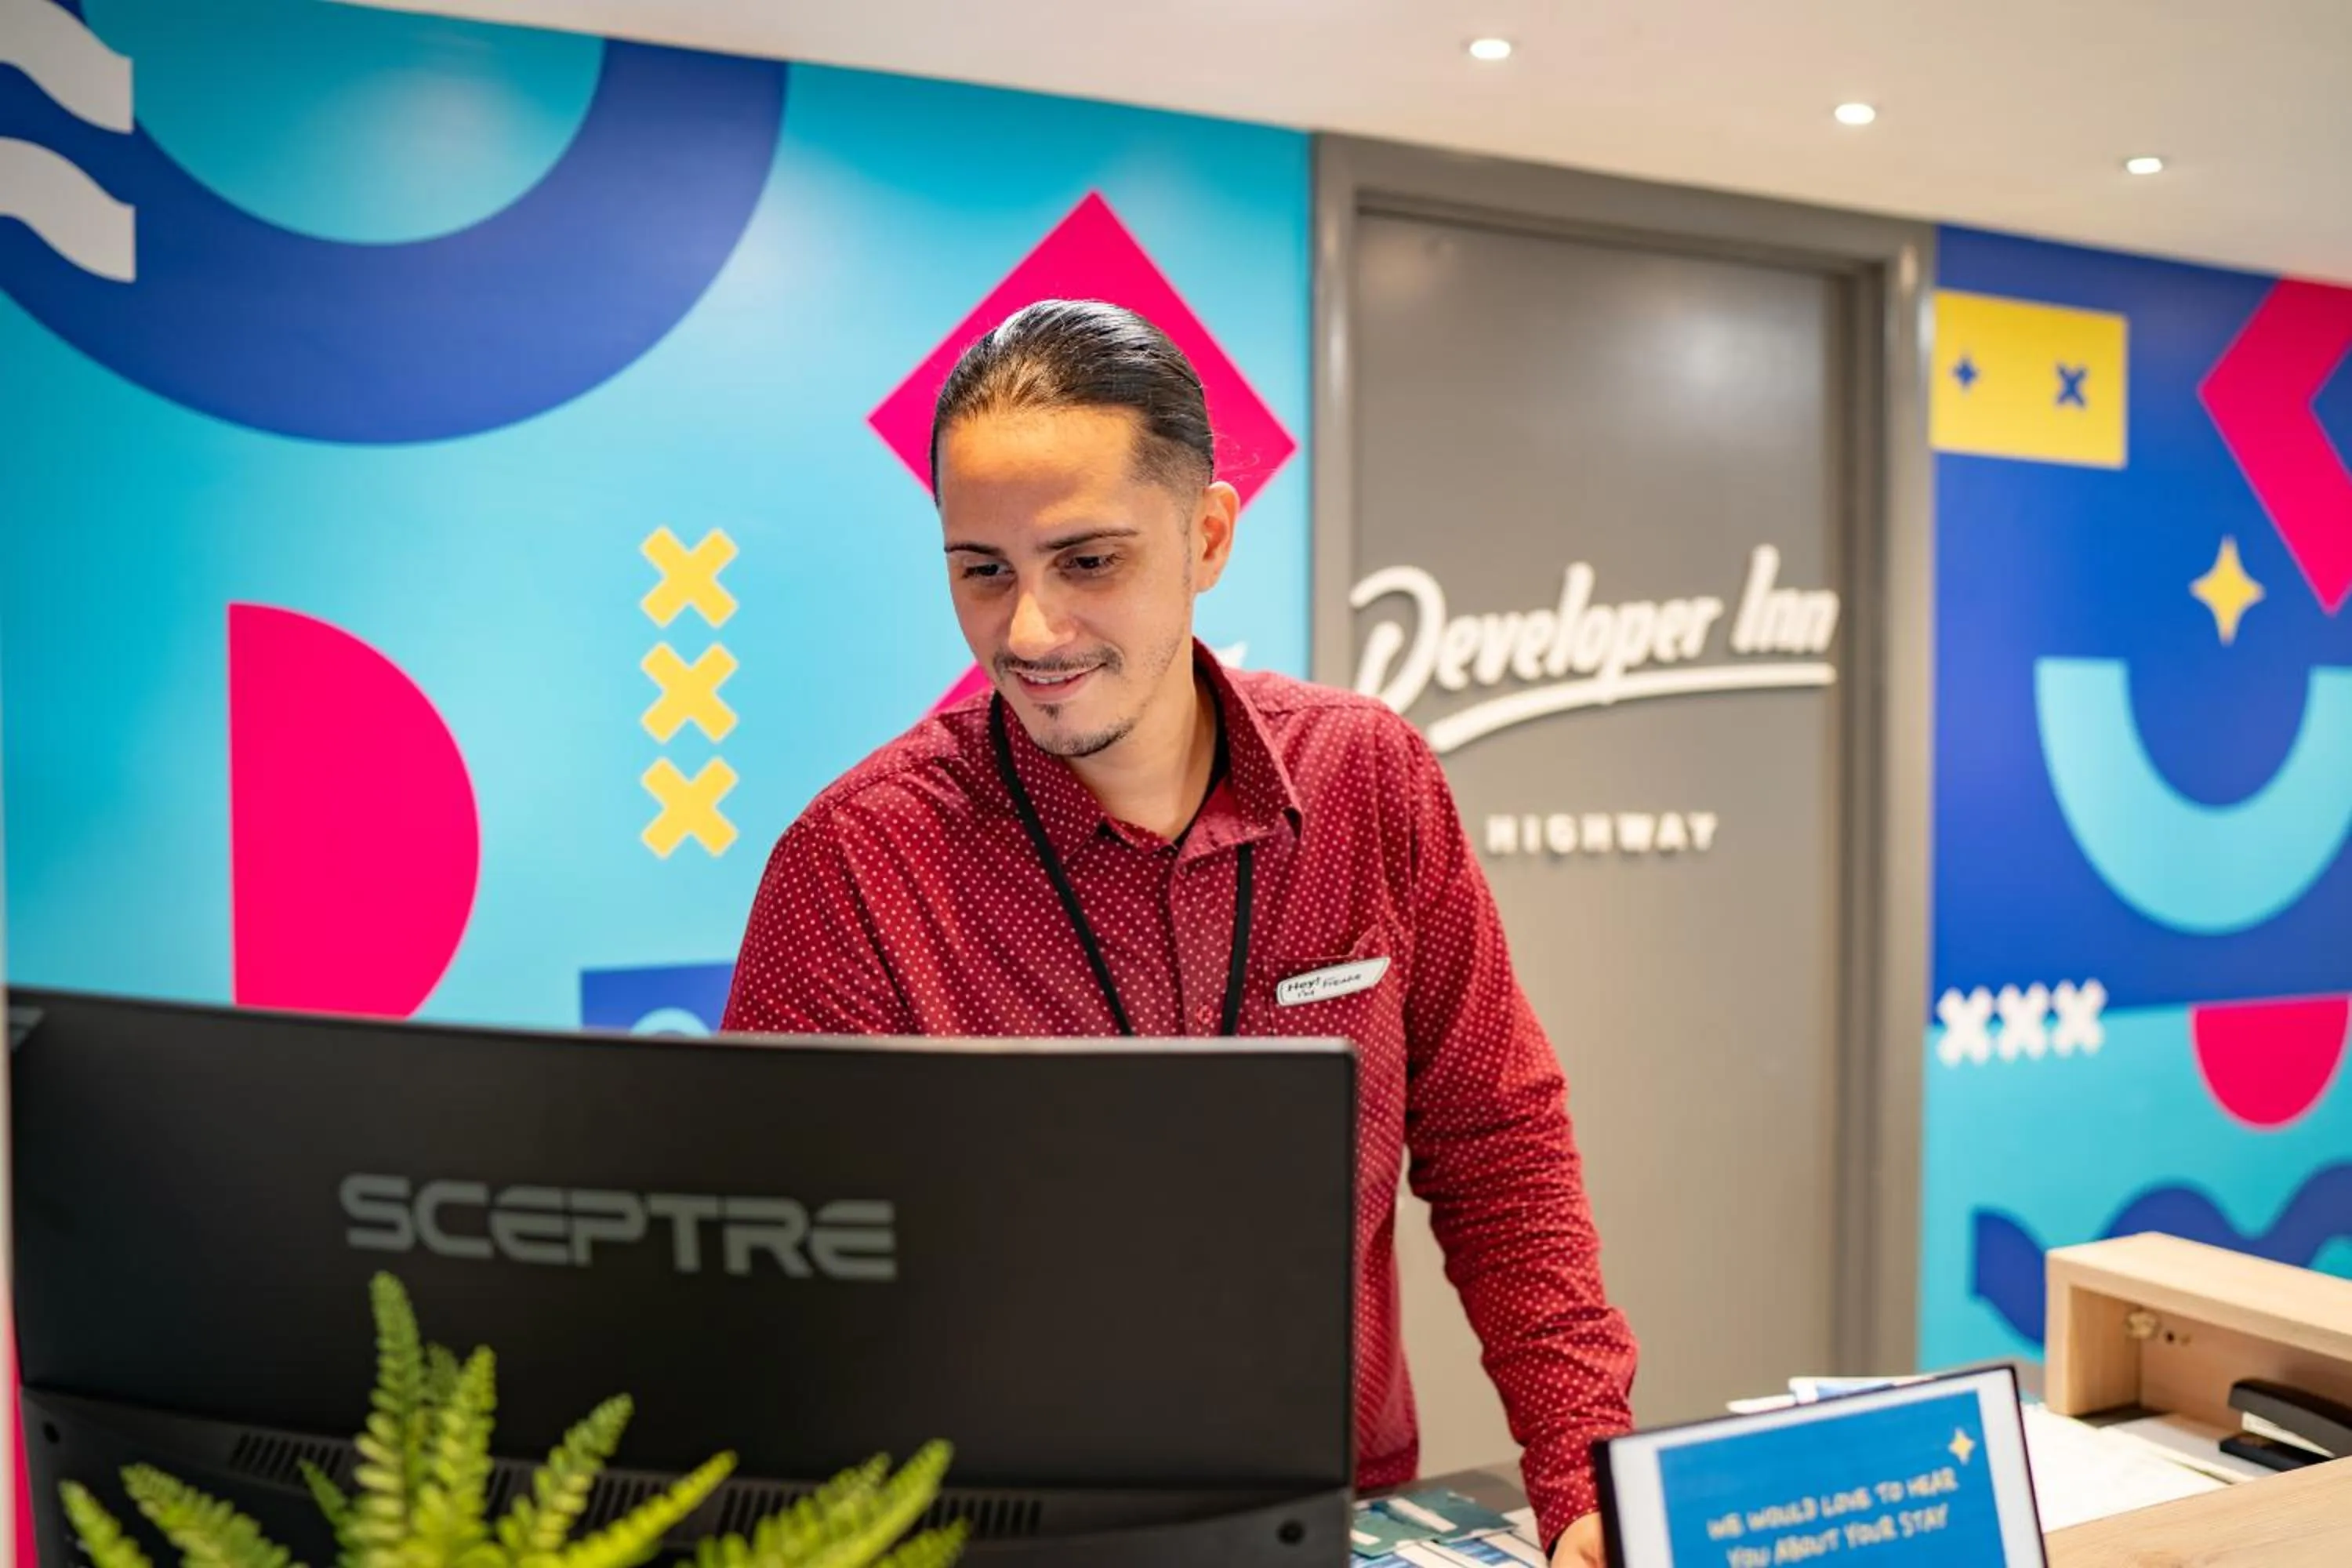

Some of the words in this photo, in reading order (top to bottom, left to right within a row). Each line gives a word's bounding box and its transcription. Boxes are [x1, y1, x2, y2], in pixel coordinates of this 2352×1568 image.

[1350, 561, 1722, 715] Developer
[1730, 544, 1839, 652] Inn
[1486, 811, 1717, 855] HIGHWAY
[339, 1174, 896, 1280] SCEPTRE
[1707, 1512, 1744, 1541] WE
[1746, 1497, 1819, 1532] WOULD
[1820, 1486, 1872, 1519] LOVE
[1874, 1480, 1905, 1504] TO
[1906, 1466, 1960, 1499] HEAR
[1773, 1526, 1839, 1566] ABOUT
[1843, 1515, 1899, 1550] YOUR
[1898, 1502, 1949, 1539] STAY
